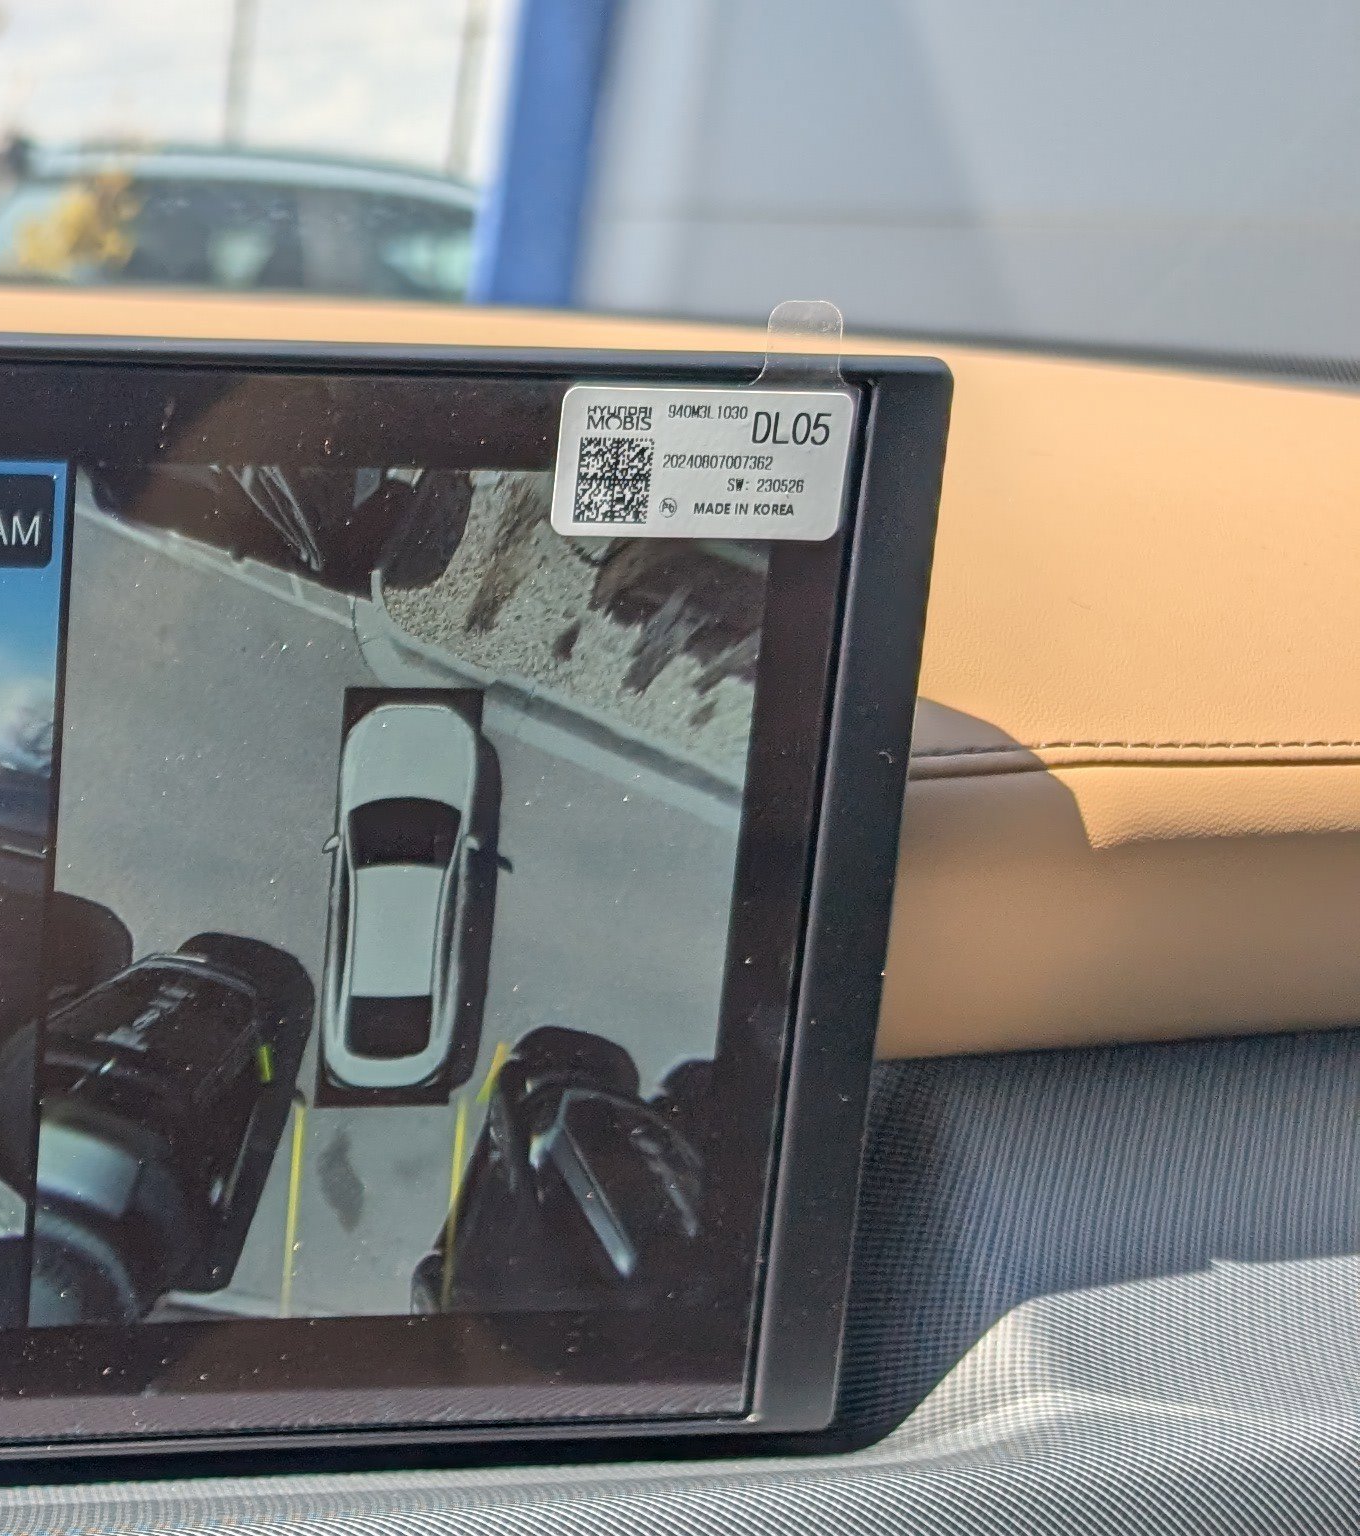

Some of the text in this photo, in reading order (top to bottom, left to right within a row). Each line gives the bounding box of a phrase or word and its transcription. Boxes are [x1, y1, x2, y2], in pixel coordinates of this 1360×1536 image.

[587, 405, 653, 418] HYUNDAI
[586, 415, 653, 431] MOBIS
[751, 411, 832, 446] DL05
[662, 454, 774, 471] 20240807007362
[756, 478, 805, 493] 230526
[693, 502, 795, 516] MADE IN KOREA
